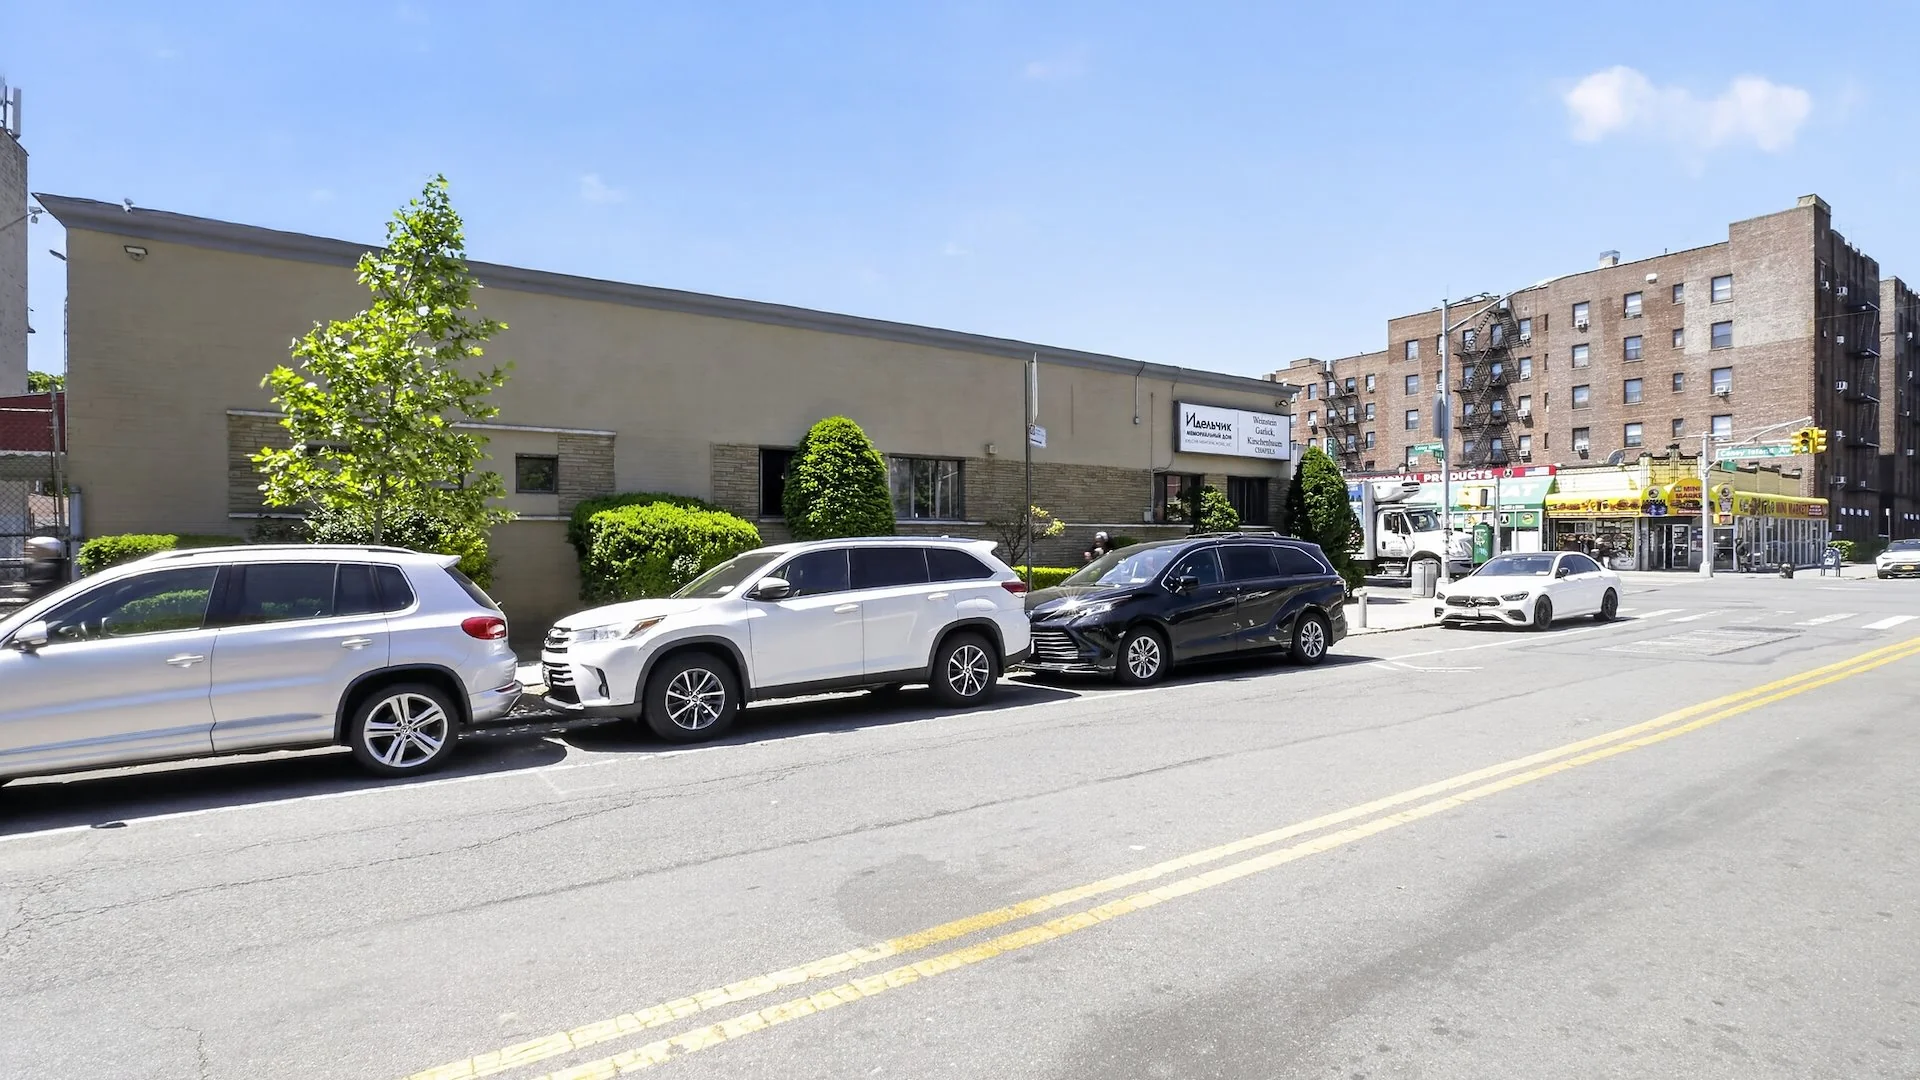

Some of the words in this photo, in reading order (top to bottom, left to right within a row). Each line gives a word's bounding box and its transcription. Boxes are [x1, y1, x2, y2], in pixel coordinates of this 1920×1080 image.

[1186, 411, 1232, 432] Идельчик
[1253, 416, 1277, 426] Weinstein
[1748, 447, 1774, 455] Island
